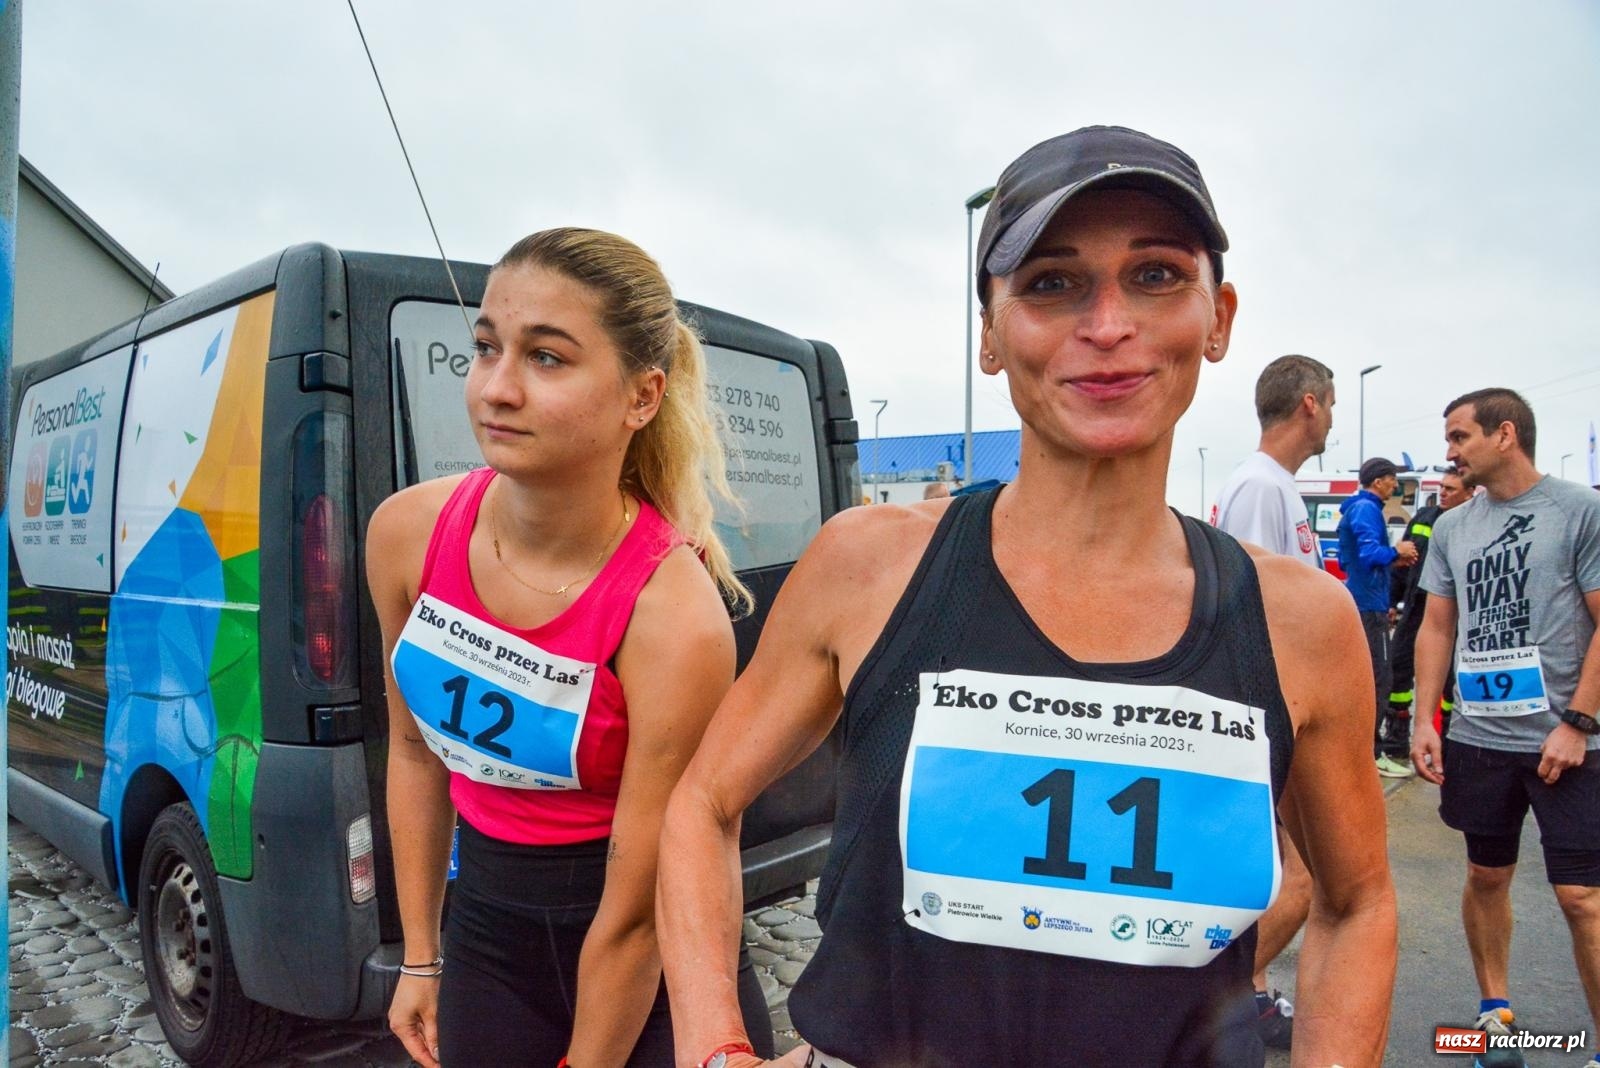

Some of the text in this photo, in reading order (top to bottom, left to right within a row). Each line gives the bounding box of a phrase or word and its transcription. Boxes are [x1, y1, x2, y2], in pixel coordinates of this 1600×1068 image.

[428, 342, 474, 377] Pe
[31, 386, 106, 437] PersonalBest
[726, 387, 752, 407] 278
[755, 392, 781, 412] 740
[759, 419, 784, 439] 596
[725, 469, 804, 489] ersonalbest.pl
[1467, 541, 1532, 584] ONLY
[1467, 568, 1531, 613] WAY
[1479, 599, 1530, 625] FINISH
[1467, 626, 1530, 653] START
[1482, 621, 1507, 635] IS TO
[37, 633, 75, 670] masaż
[417, 605, 580, 686] Eko Cross przez Las
[443, 639, 469, 658] Kornice,
[468, 651, 479, 662] 30
[478, 657, 508, 677] września
[507, 670, 527, 685] 2023
[16, 666, 66, 720] biegowe
[1476, 672, 1514, 700] 19
[440, 674, 515, 759] 12
[933, 685, 1256, 741] Eko Cross przez Las
[1005, 722, 1195, 752] Kornice, 30 września 2023 r.
[1020, 768, 1174, 890] 11
[947, 909, 1003, 921] Pietrowice Wielkie
[948, 901, 984, 910] UKS START
[1043, 922, 1073, 931] LEPSZEGO
[1044, 917, 1071, 925] AKTYWNI
